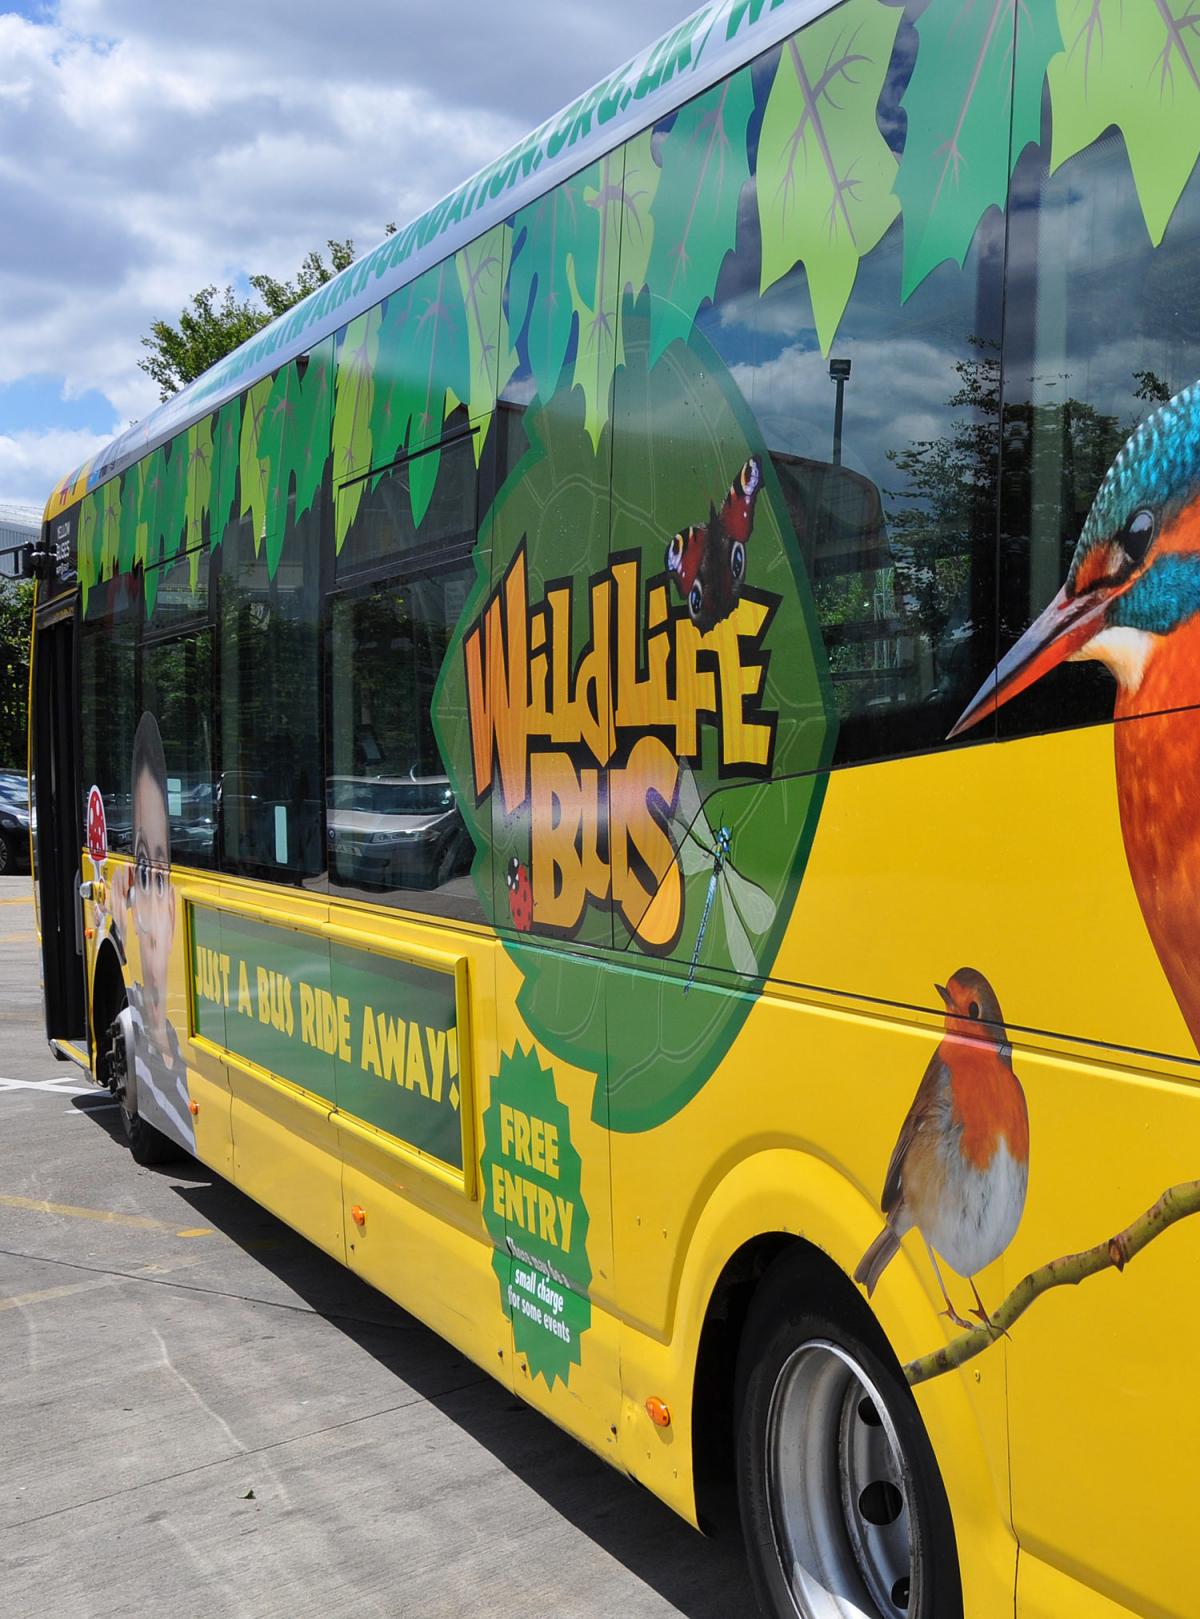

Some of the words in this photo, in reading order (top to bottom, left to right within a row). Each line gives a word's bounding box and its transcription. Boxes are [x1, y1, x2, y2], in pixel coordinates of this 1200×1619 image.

[530, 735, 684, 946] BUS
[195, 945, 230, 1008] JUST
[238, 960, 253, 1017] A
[256, 966, 294, 1038] BUS
[300, 982, 352, 1064] RIDE
[361, 1005, 460, 1112] AWAY!
[500, 1103, 560, 1180] FREE
[491, 1163, 574, 1254] ENTRY
[507, 1284, 521, 1310] for
[521, 1298, 542, 1325] some
[543, 1313, 571, 1344] events
[515, 1268, 537, 1294] small
[537, 1278, 564, 1315] charge
